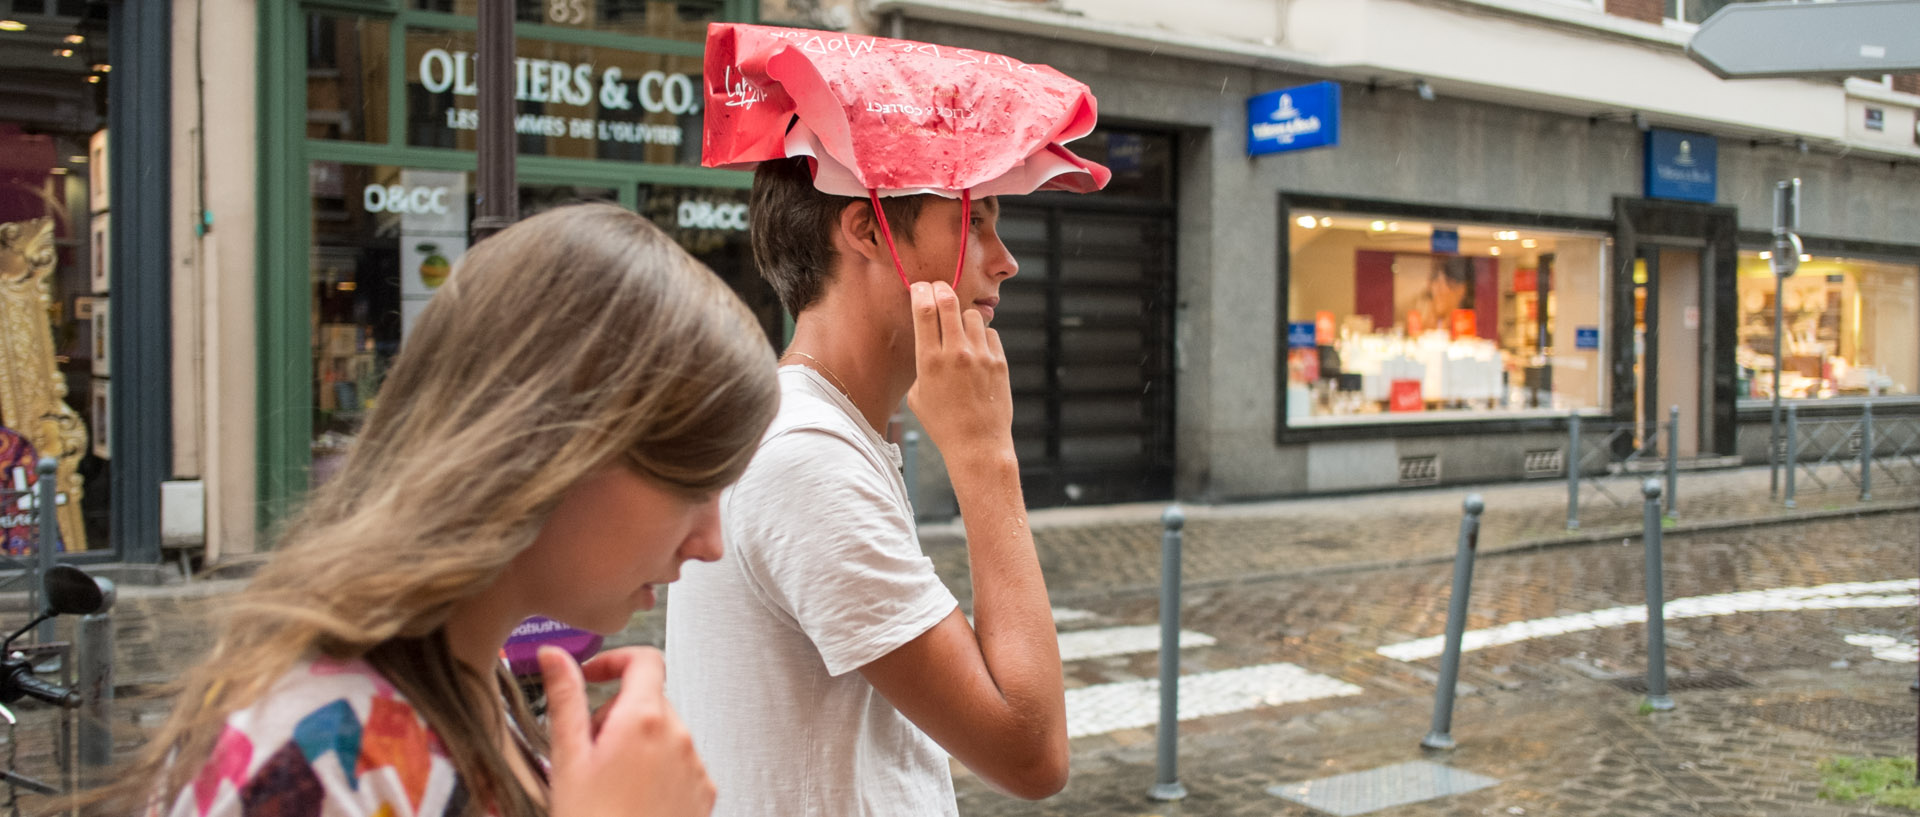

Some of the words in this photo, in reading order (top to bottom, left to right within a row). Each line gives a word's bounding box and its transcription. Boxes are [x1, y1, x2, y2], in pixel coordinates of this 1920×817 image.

[549, 0, 584, 25] 85
[419, 48, 593, 106] OLIERS
[599, 67, 632, 110] &
[638, 71, 700, 115] CO.
[866, 101, 923, 118] COLLECT
[925, 105, 934, 115] &
[935, 105, 974, 119] CLICK
[446, 107, 478, 130] LES
[569, 118, 595, 140] DE
